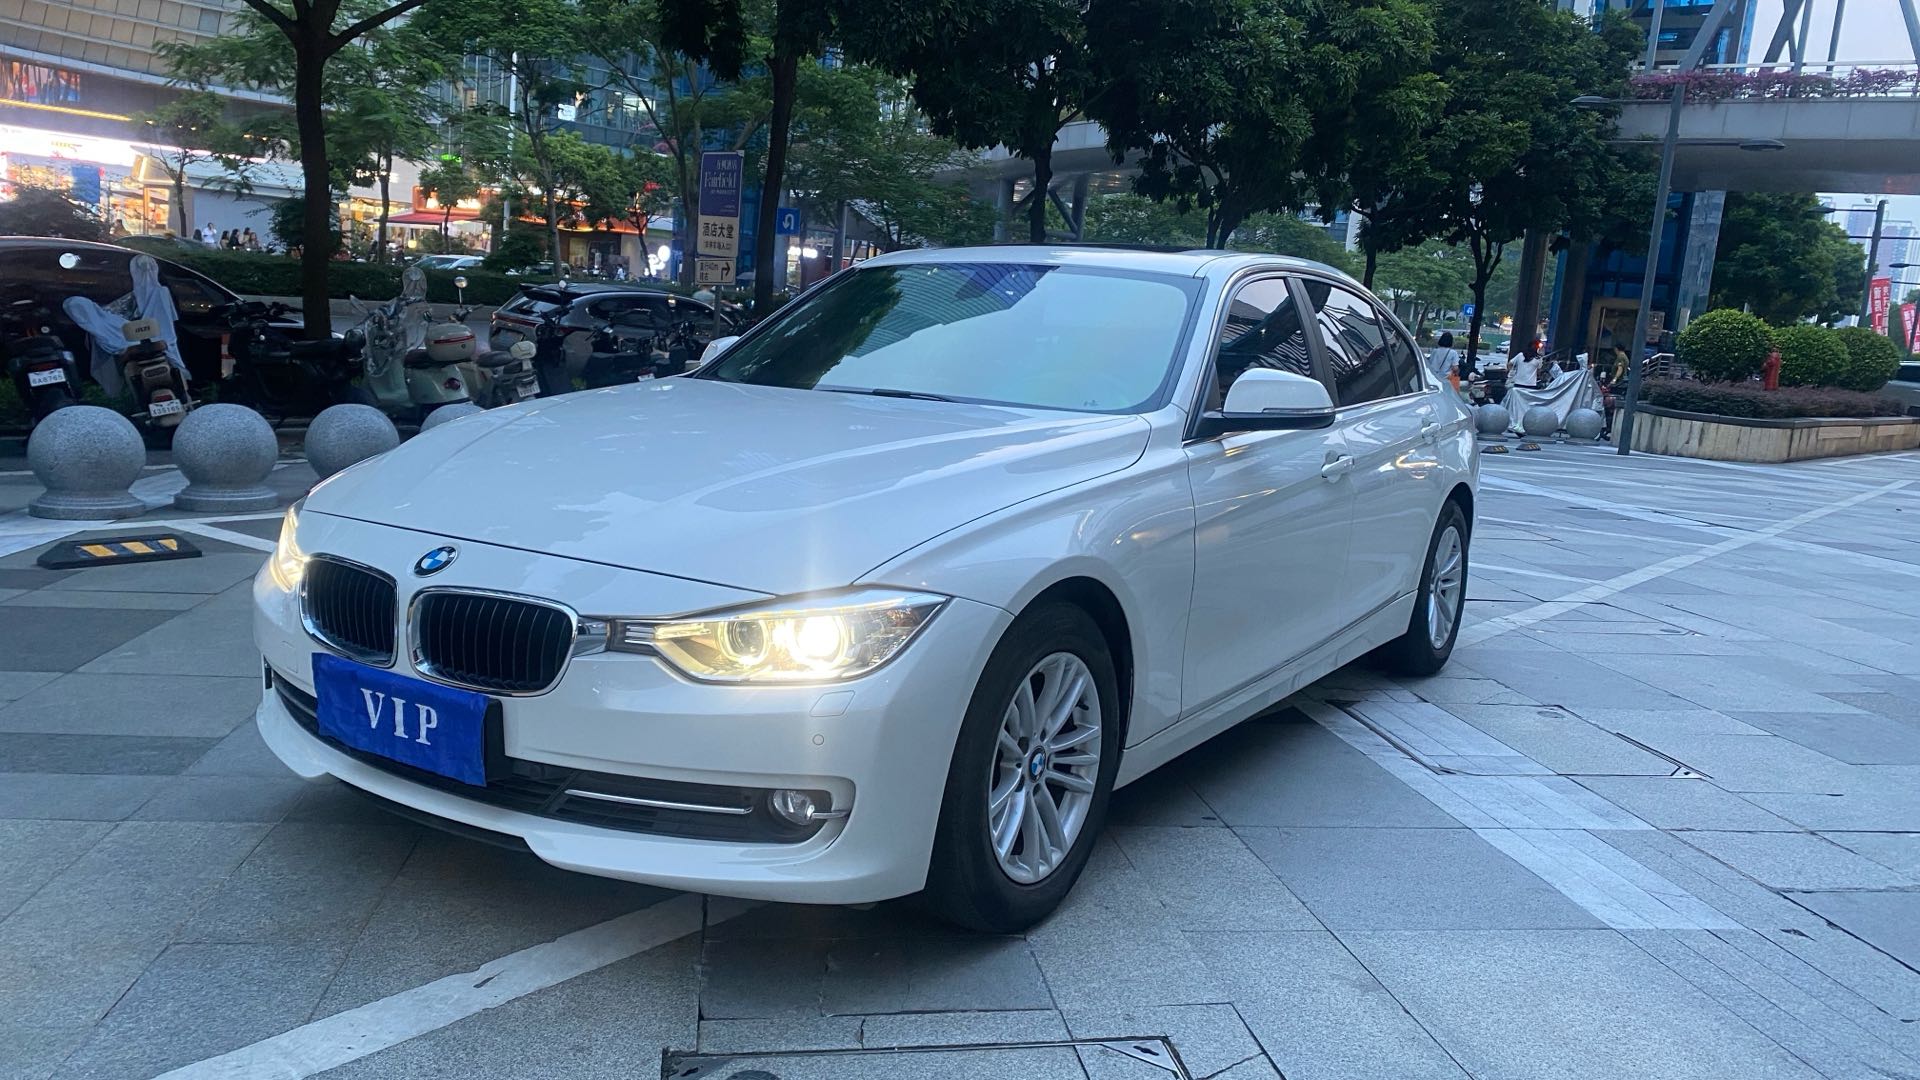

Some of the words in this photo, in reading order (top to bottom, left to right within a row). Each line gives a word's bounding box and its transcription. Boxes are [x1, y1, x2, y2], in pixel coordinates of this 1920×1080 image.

[704, 172, 737, 188] Fairfield
[702, 222, 734, 239] 酒店大堂
[360, 687, 438, 746] VIP
